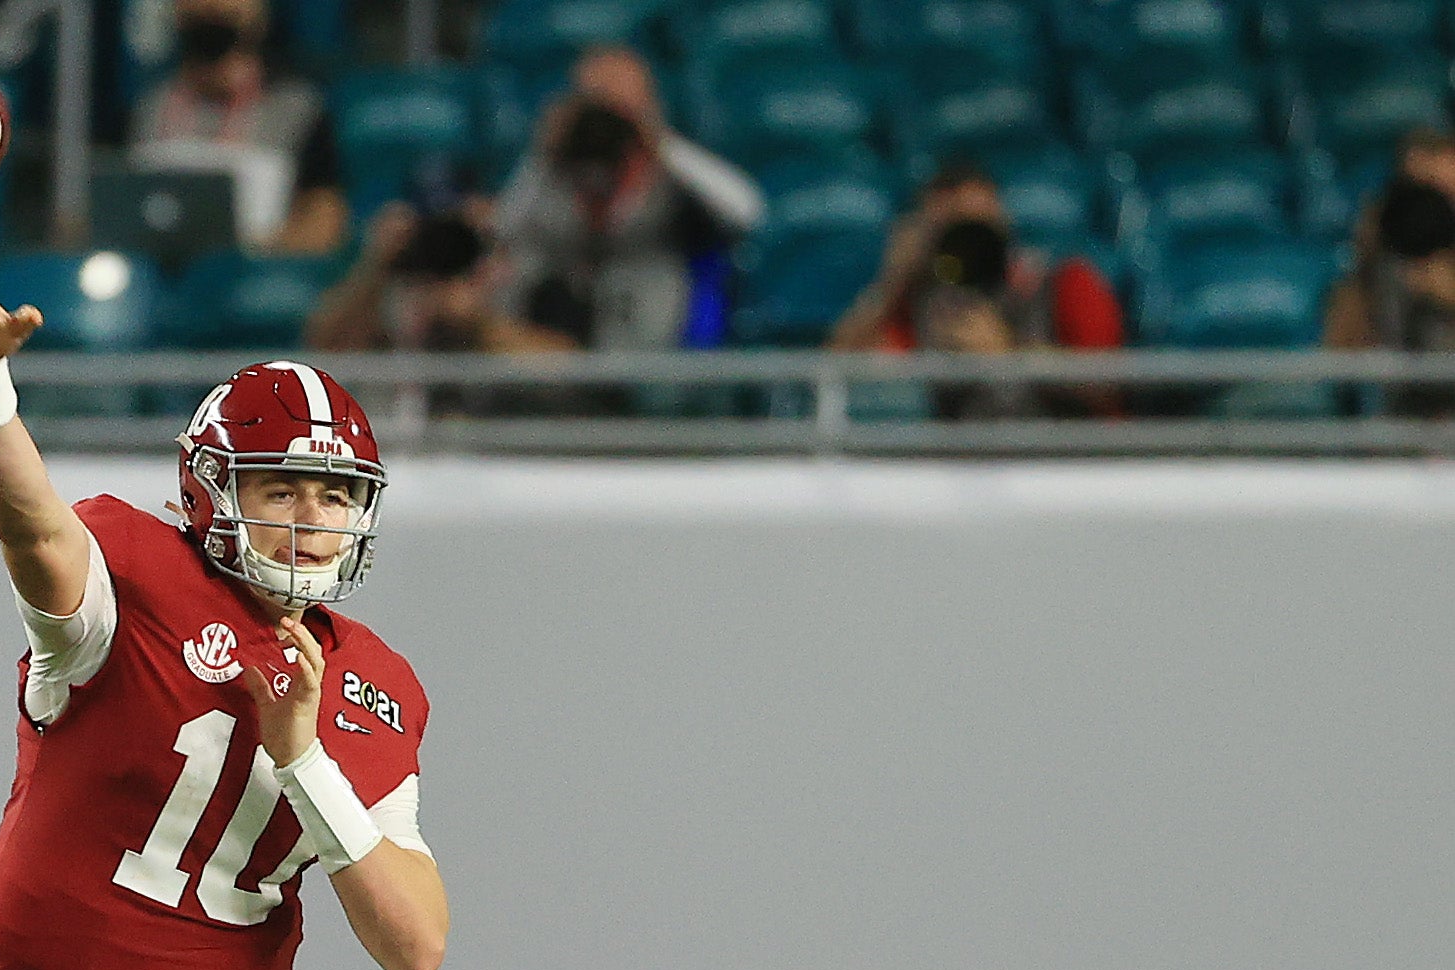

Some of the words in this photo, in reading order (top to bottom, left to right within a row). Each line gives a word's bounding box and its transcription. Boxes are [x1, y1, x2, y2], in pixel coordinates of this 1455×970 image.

[309, 439, 343, 456] BAMA
[185, 651, 231, 682] GRADUATE
[196, 622, 238, 667] SEC
[343, 671, 406, 735] 2021
[111, 709, 319, 926] 10
